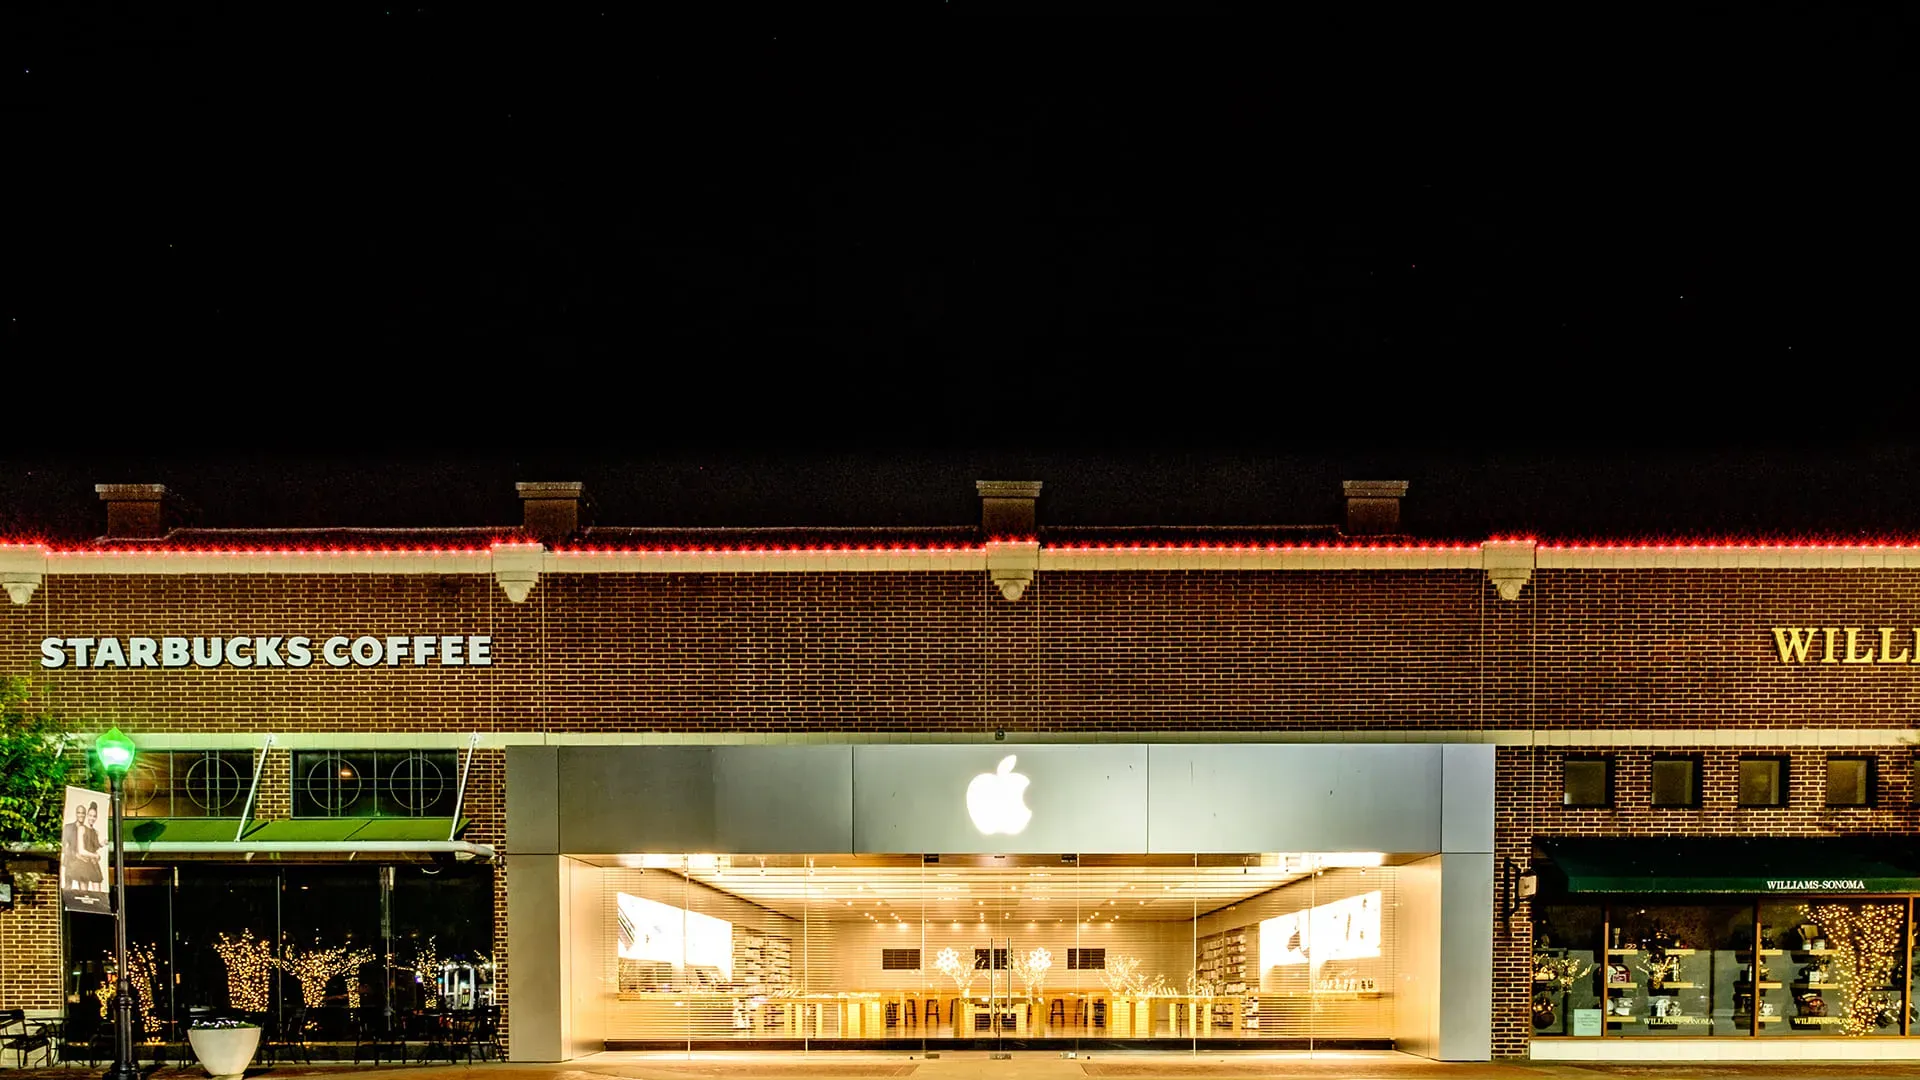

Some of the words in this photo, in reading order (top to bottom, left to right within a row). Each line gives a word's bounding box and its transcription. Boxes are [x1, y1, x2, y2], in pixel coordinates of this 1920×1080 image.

[40, 636, 313, 668] STARBUCKS
[323, 636, 492, 667] COFFEE
[1766, 880, 1866, 890] WILLIAMS-SONOMA
[1643, 1017, 1715, 1025] WILLIAMS-SONOMA
